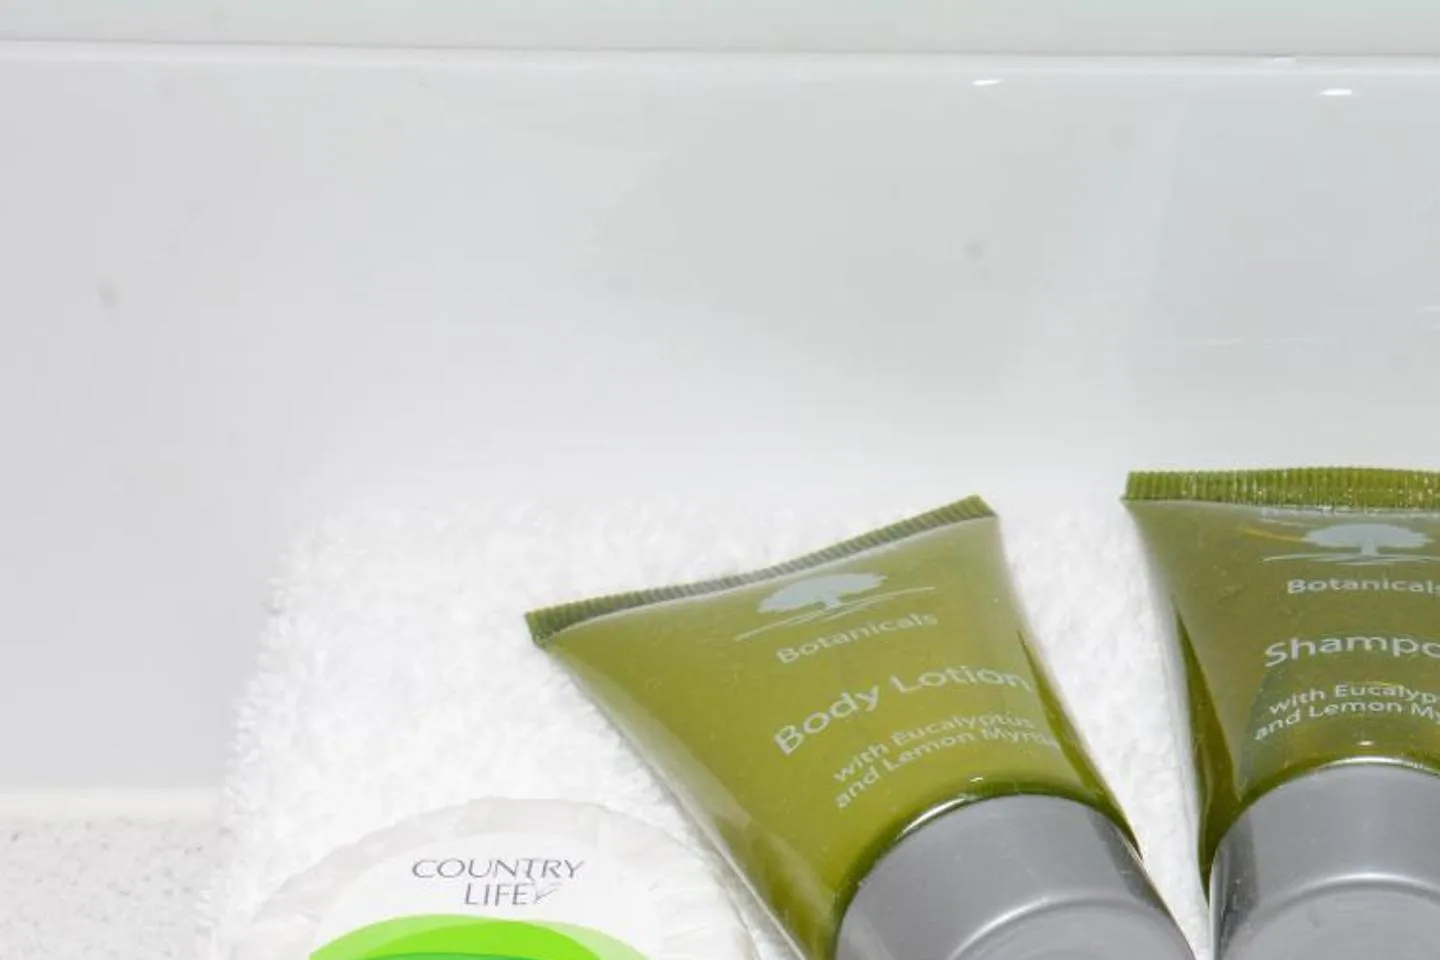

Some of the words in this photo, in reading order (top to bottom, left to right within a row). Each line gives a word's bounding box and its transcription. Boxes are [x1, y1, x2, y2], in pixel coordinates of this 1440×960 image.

[776, 613, 938, 664] Botanicals
[773, 684, 880, 757] Body
[889, 665, 1033, 693] Lotion
[1254, 711, 1301, 741] and
[1310, 700, 1403, 718] Lemon
[1269, 686, 1326, 715] with
[833, 741, 889, 783] with
[892, 710, 1035, 746] Eucalyptus
[836, 766, 880, 808] and
[885, 729, 975, 770] Lemon
[411, 858, 586, 881] COUNTRY
[465, 882, 528, 906] LIFE
